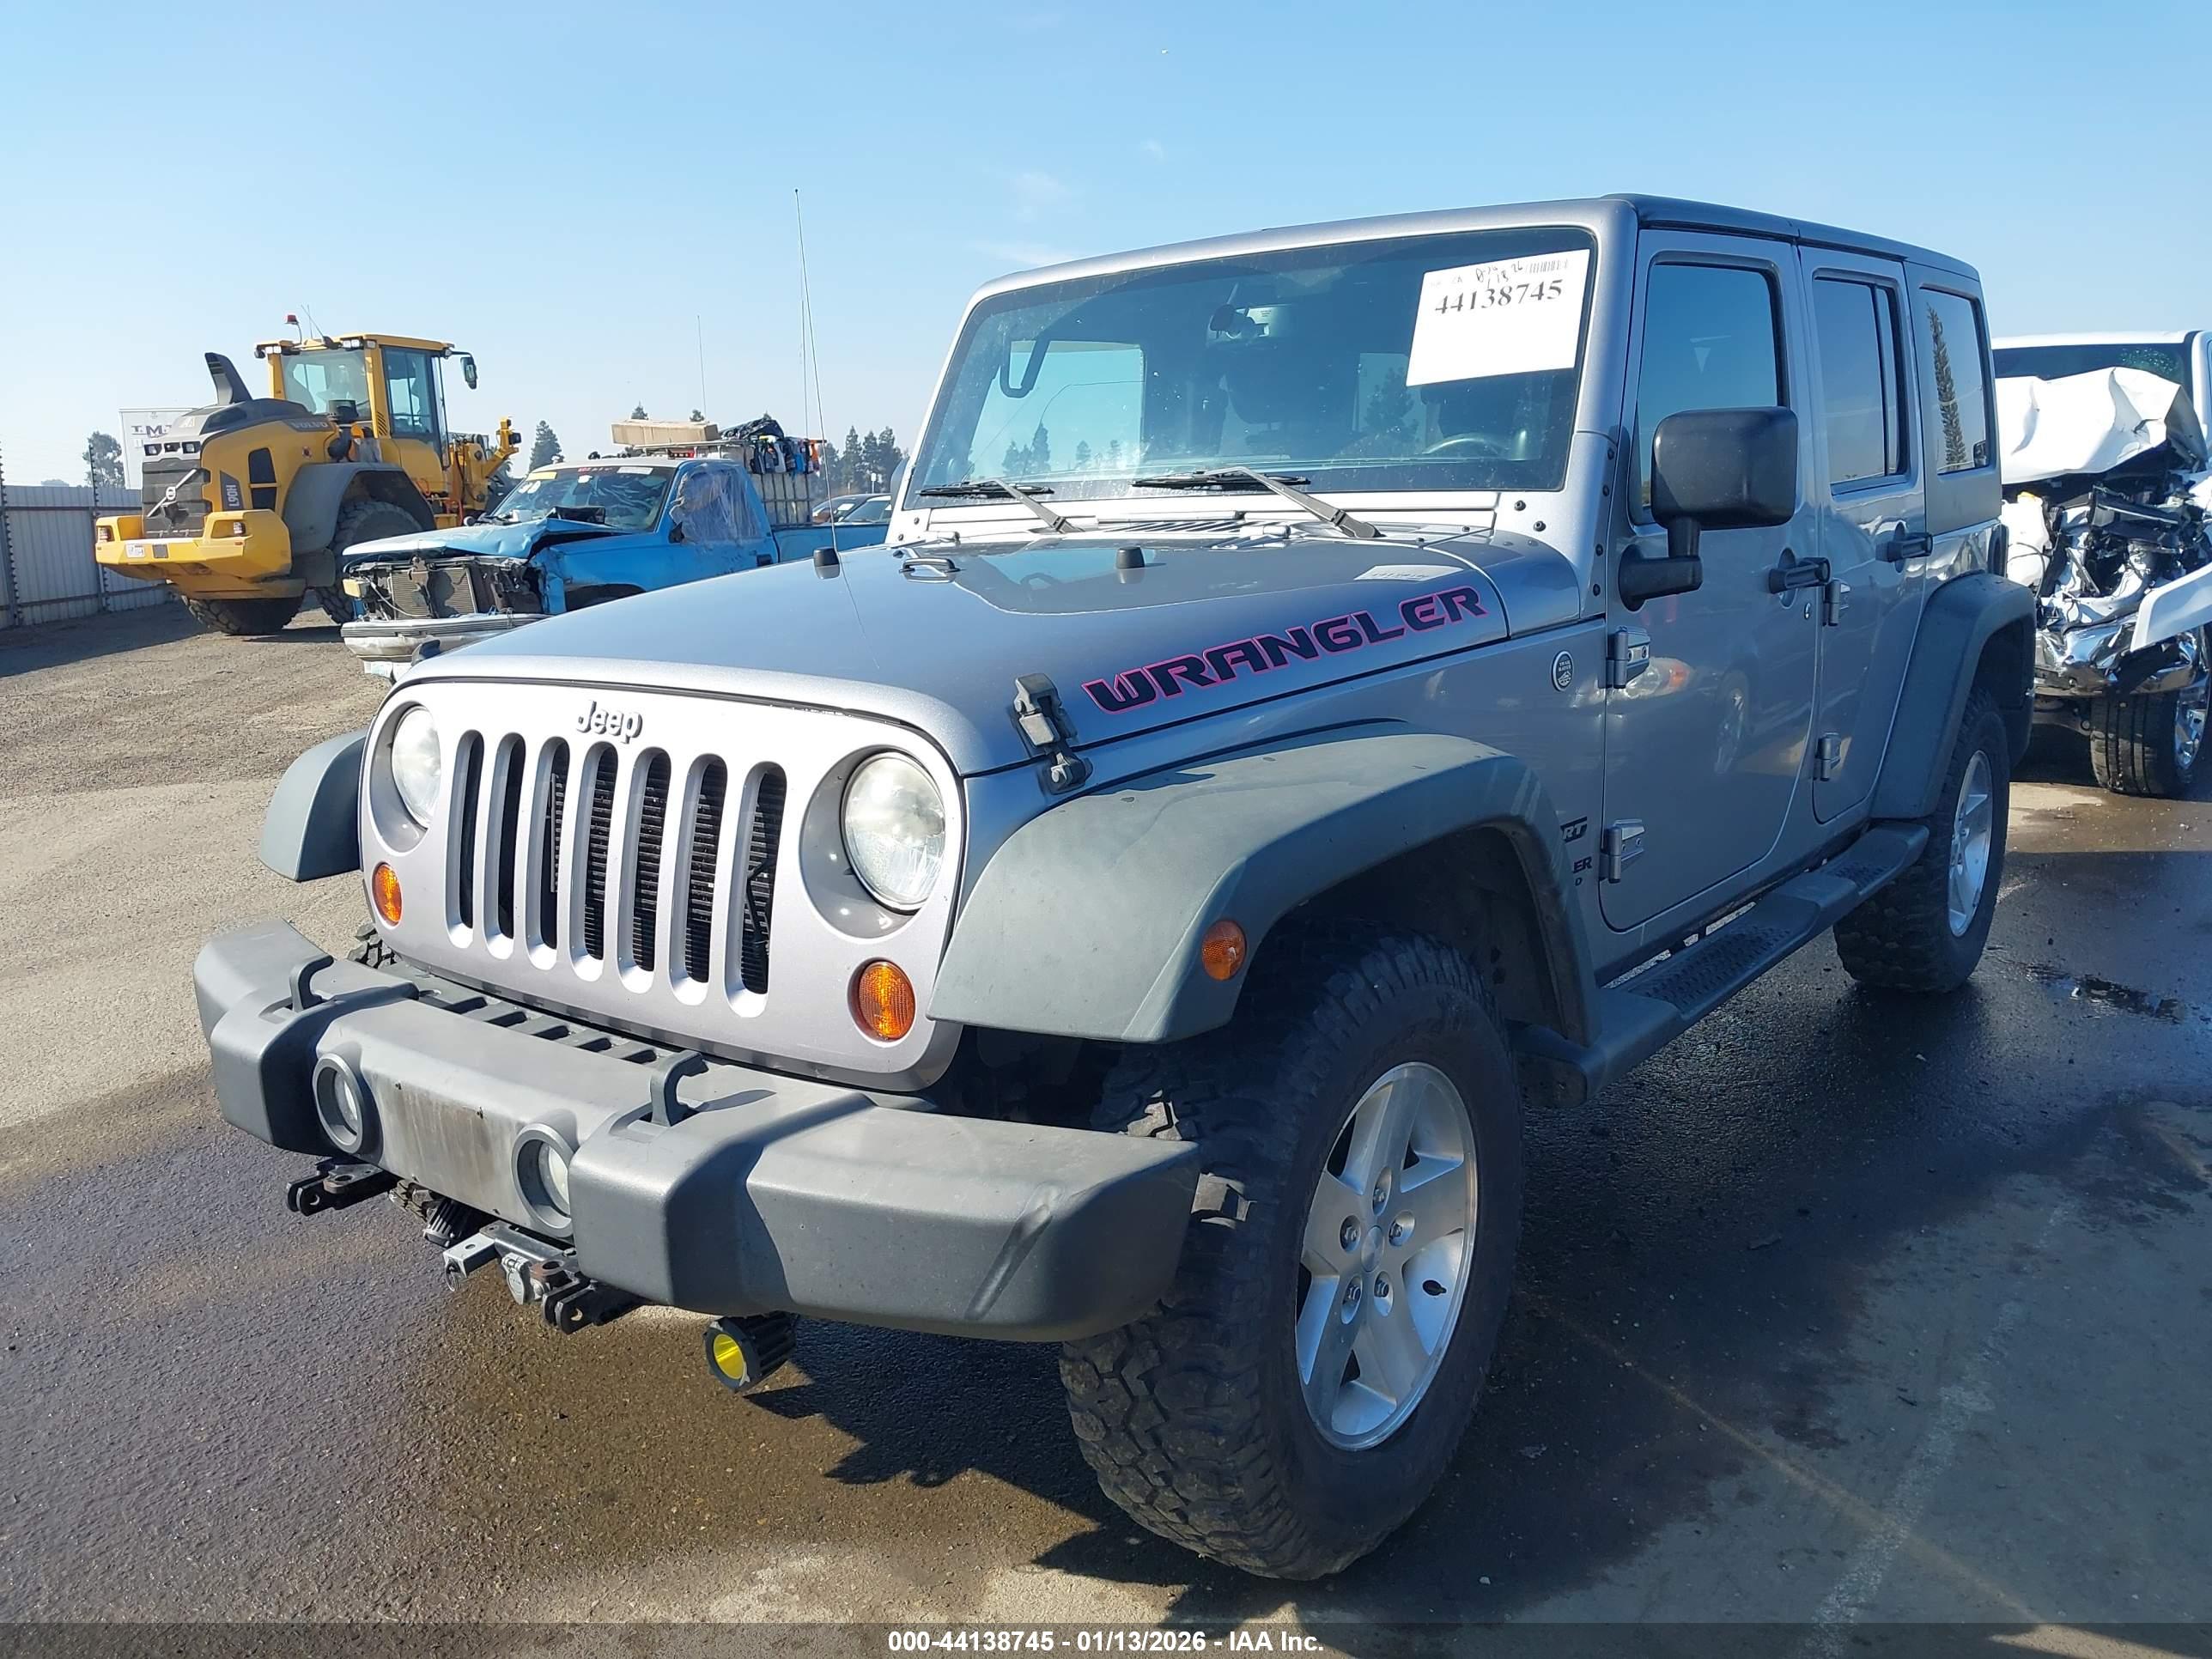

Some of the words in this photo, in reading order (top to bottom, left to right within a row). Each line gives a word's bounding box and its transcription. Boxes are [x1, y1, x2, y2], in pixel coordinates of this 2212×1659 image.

[1435, 279, 1563, 314] 44138745
[226, 484, 240, 507] L90H
[1081, 586, 1488, 714] WRANGLER
[576, 699, 642, 744] Jeep
